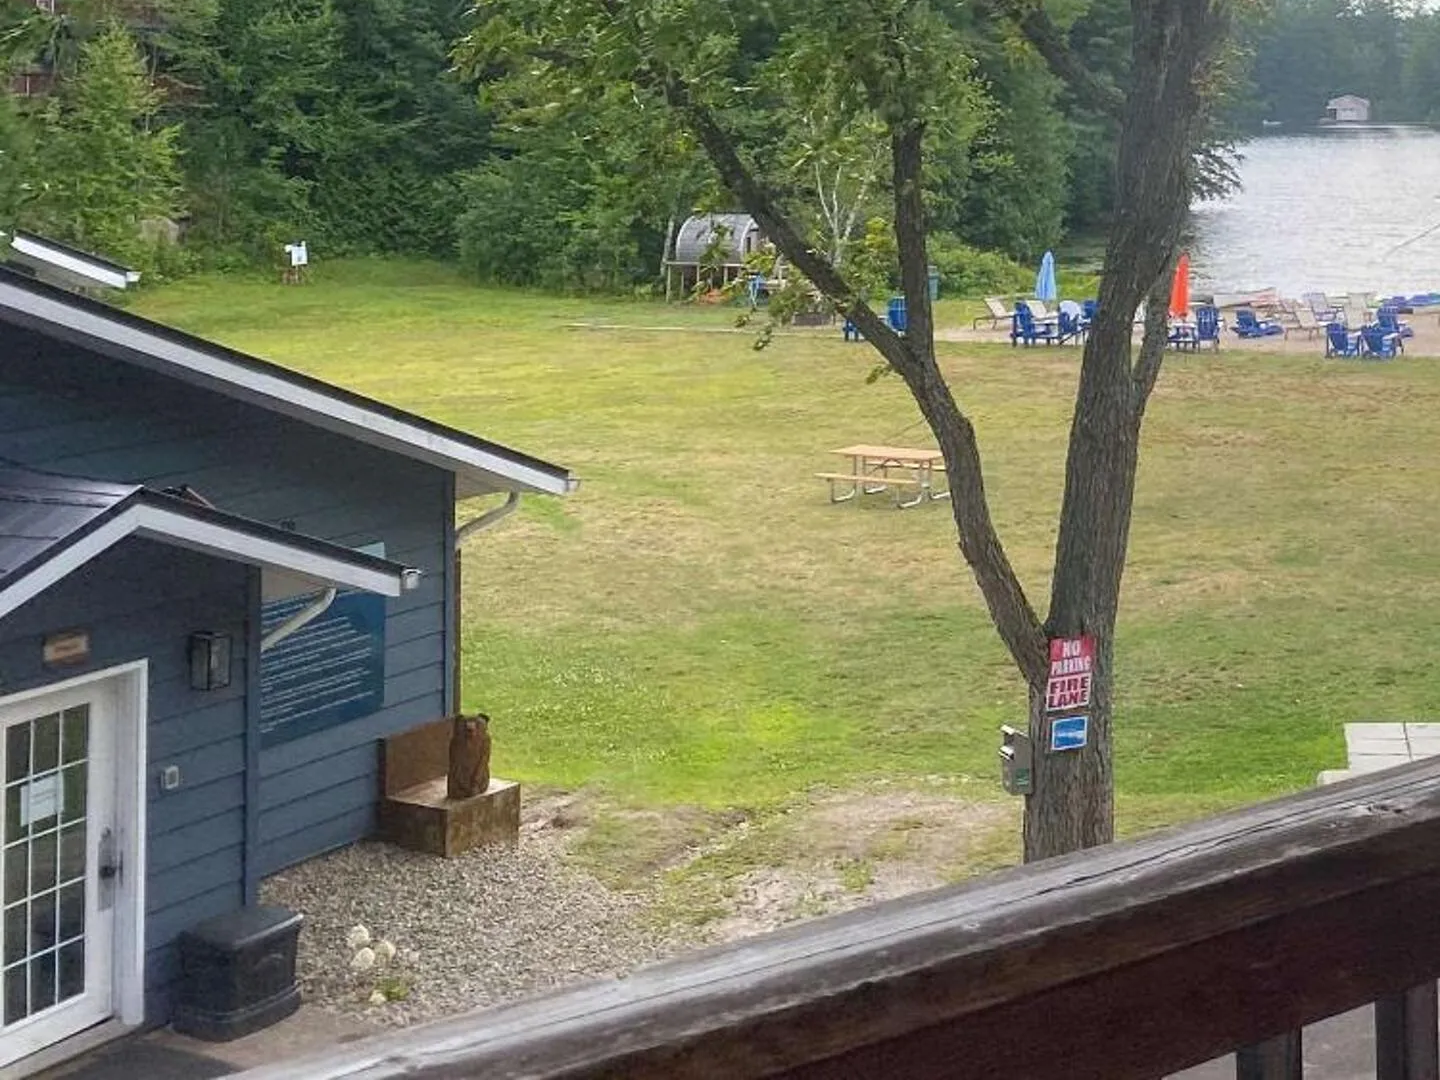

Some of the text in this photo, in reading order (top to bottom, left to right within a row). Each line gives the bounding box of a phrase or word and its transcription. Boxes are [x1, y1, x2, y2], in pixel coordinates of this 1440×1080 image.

[1063, 640, 1081, 658] NO
[1050, 677, 1089, 694] FIRE
[1048, 690, 1087, 708] LANE
